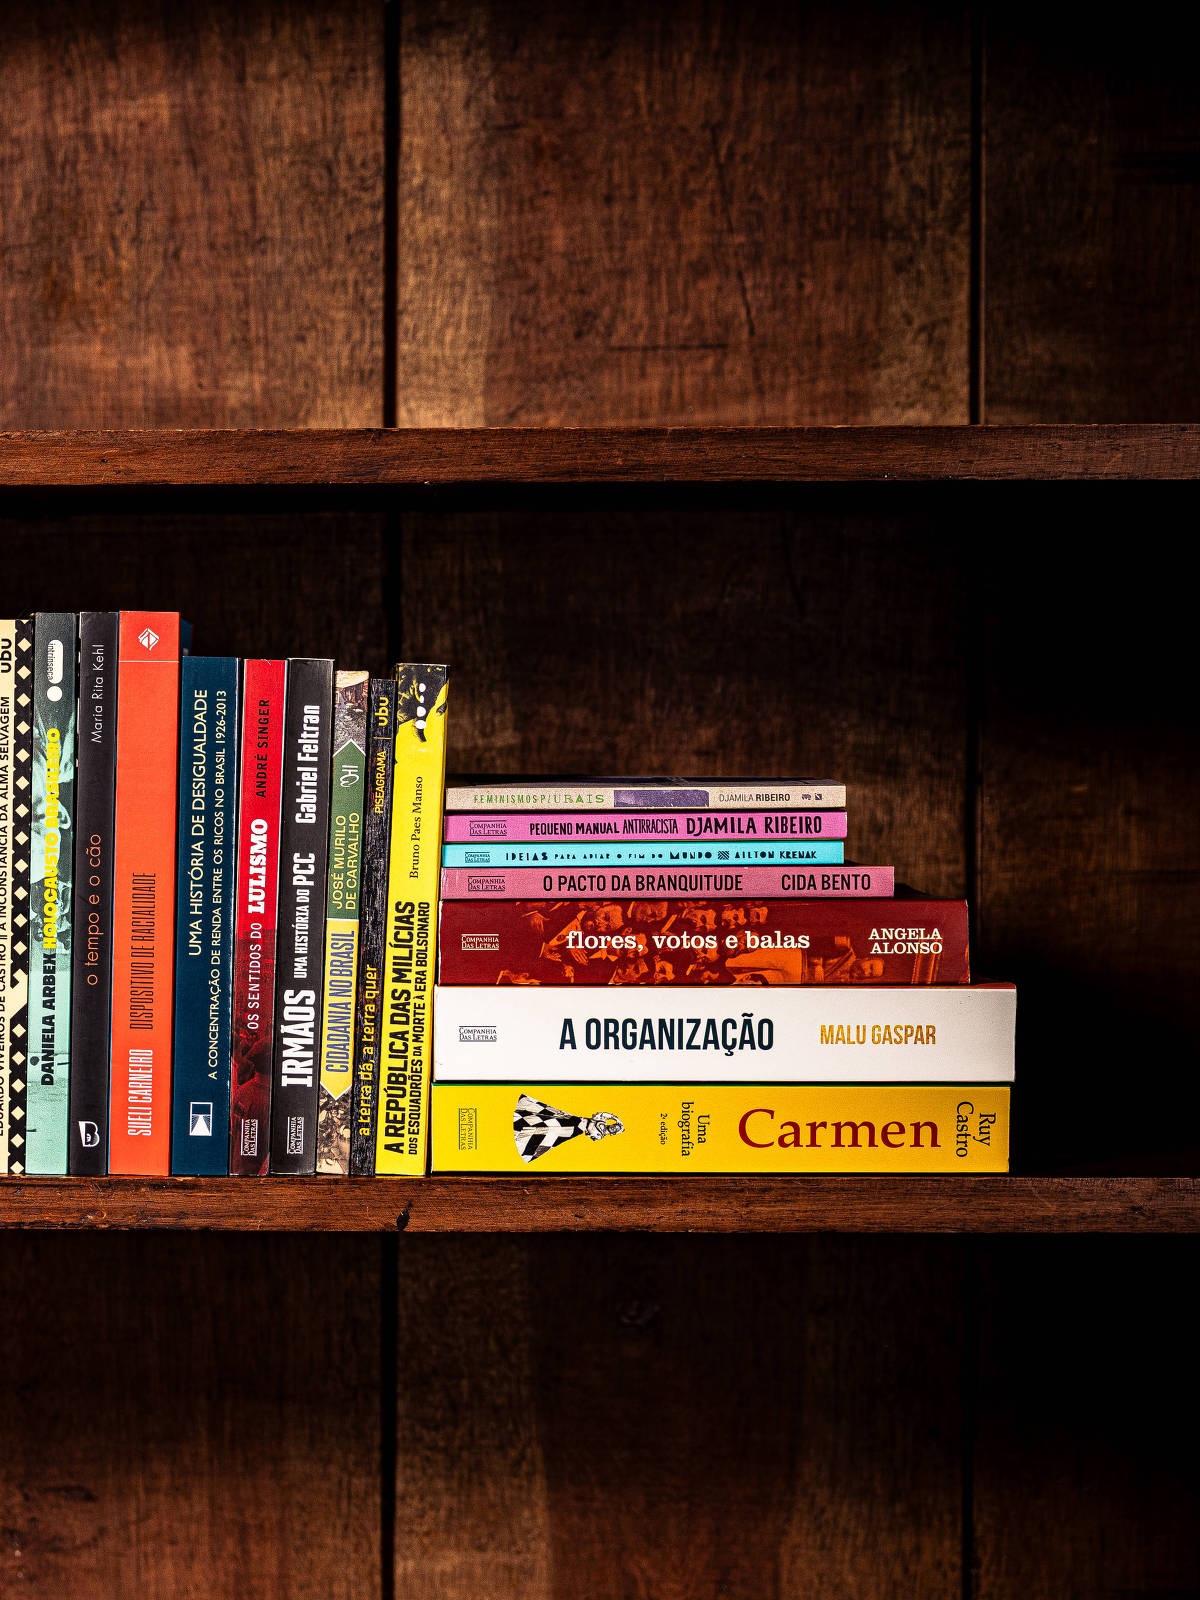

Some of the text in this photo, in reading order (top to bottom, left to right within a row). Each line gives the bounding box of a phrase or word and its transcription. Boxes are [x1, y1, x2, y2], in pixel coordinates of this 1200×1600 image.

[91, 644, 104, 743] Maria Rita Kehl
[374, 696, 389, 727] ubu
[0, 697, 9, 761] SELVAGEM
[255, 699, 270, 798] ANDRÉ SINGER
[0, 765, 9, 800] ALMA
[295, 705, 320, 823] Gabriel Feltran
[374, 750, 386, 814] PISEAGRAMA
[0, 804, 8, 821] DA
[188, 690, 207, 955] UMA HISTÓRIA DE DESIGUALDADE
[409, 776, 423, 879] Bruno Paes Manso
[530, 818, 678, 835] PEQUENO MANUAL ANTIRRACISTA
[686, 816, 822, 836] DJAMILA RIBEIRO
[719, 793, 790, 802] DJAMILA RIBEIRO
[43, 728, 61, 949] HOLOCAUSTO BRASILEIRO
[331, 815, 346, 909] JOSÉ MURILO
[345, 812, 360, 910] DE CARVALHO
[84, 834, 104, 986] o tempo e o cão
[543, 874, 743, 892] O PACTO DA BRANQUITUDE
[781, 874, 871, 891] CIDA BENTO
[247, 819, 268, 1029] OS SENTIDOS DO LULISMO
[291, 853, 315, 978] UMA HISTÓRIA DO PCC
[566, 930, 810, 953] flores, votos e balas
[868, 928, 943, 940] ANGELA
[870, 941, 943, 954] ALONSO
[129, 872, 156, 1030] DISPOSITIVO DE RACIALIDADE
[41, 952, 57, 1086] DANIELA ARBEX
[325, 930, 355, 1073] CIDADANIA NO BRASIL
[384, 901, 415, 1154] A REPÚBLICA DAS MILÍCIAS
[280, 989, 316, 1087] IRMÃOS
[559, 1012, 774, 1057] A ORGANIZAÇÃO
[820, 1024, 936, 1045] MALU GASPAR
[127, 1049, 153, 1136] SUELI CARNEIRO
[677, 1102, 694, 1157] biografia
[697, 1114, 710, 1144] Uma
[738, 1108, 941, 1148] Carmen
[956, 1101, 974, 1157] Castro
[972, 1112, 996, 1146] Ruy
